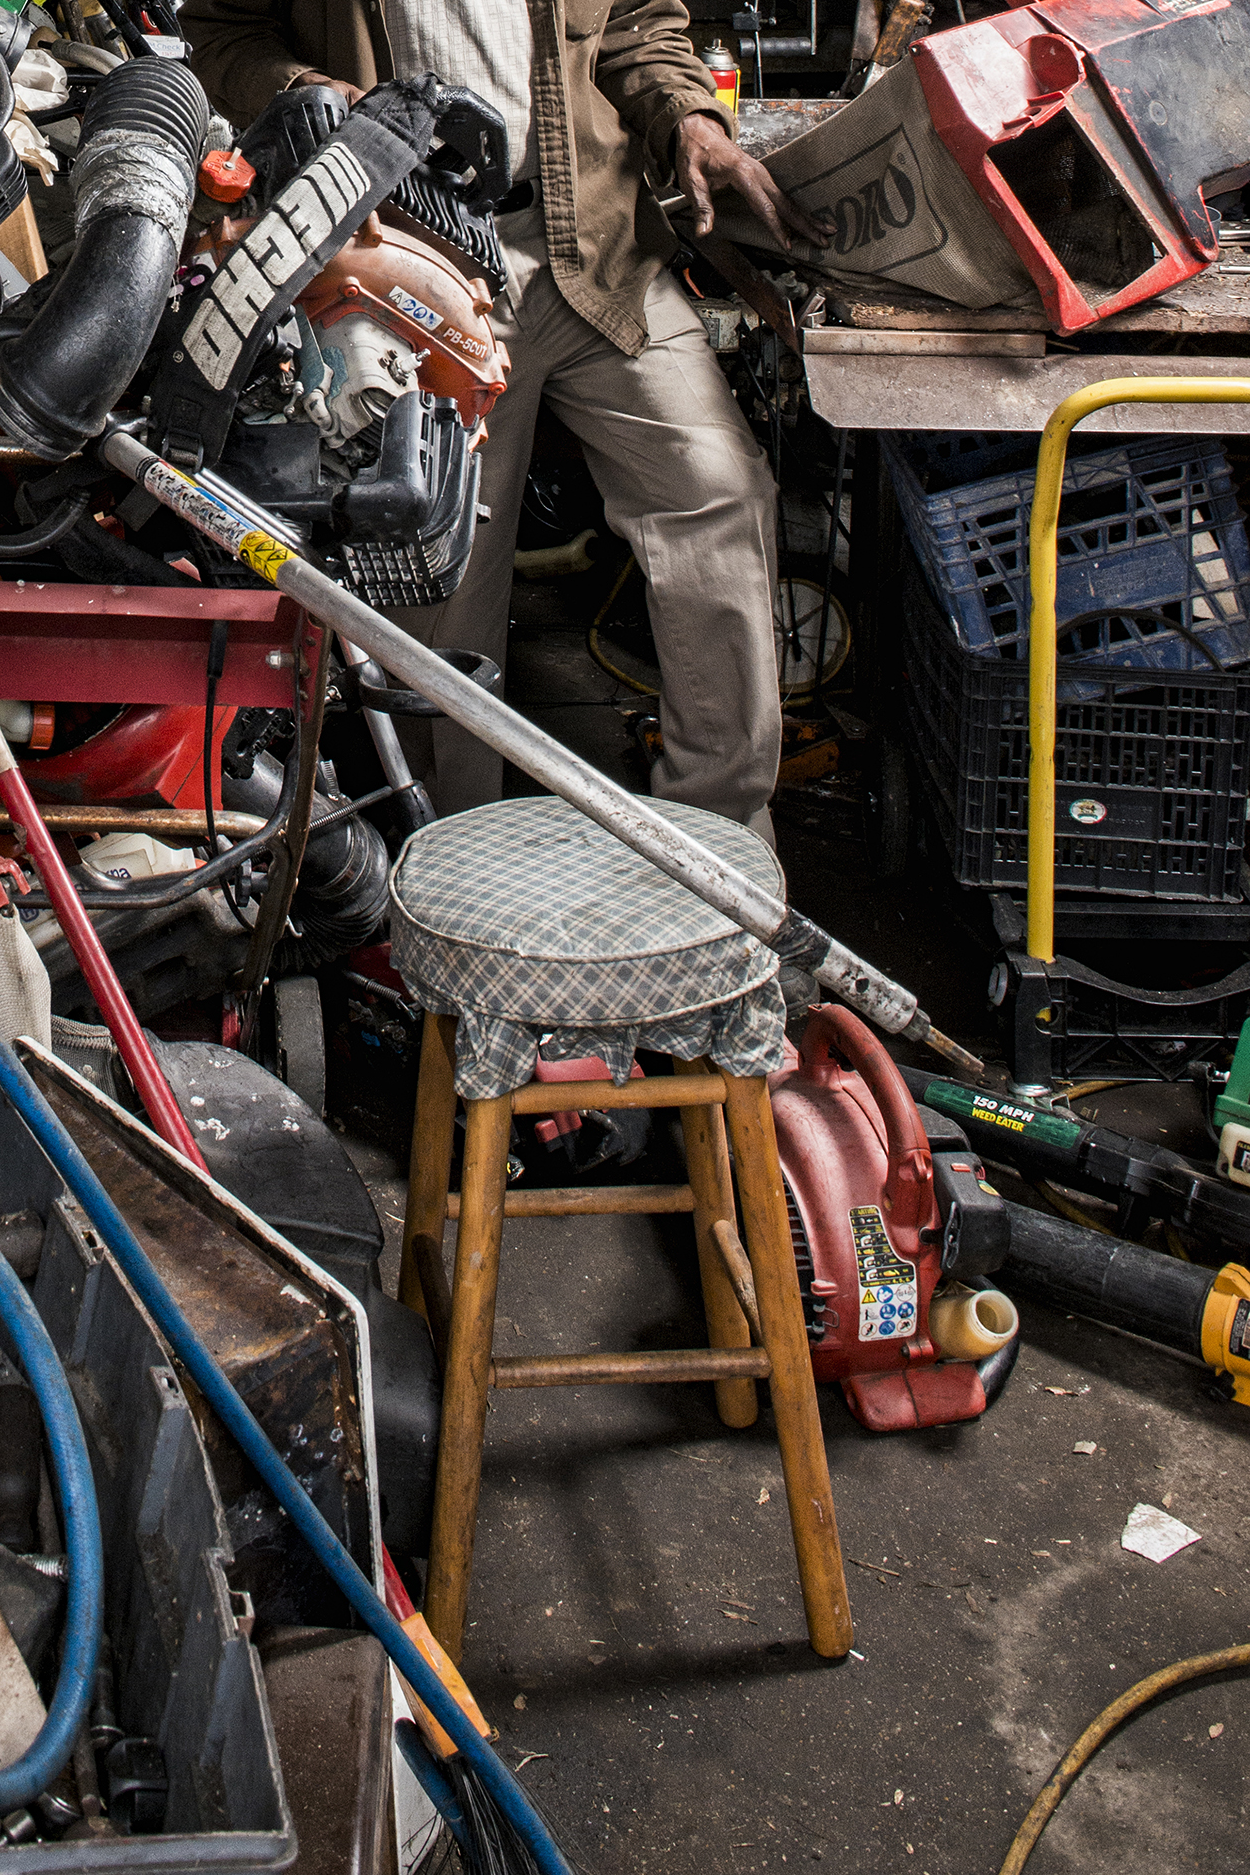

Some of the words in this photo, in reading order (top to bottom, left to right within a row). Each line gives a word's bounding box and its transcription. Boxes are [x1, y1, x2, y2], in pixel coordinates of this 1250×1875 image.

[181, 178, 336, 391] ECHO
[971, 1107, 997, 1123] WEED
[995, 1115, 1026, 1133] EATER
[972, 1095, 999, 1111] 150
[998, 1104, 1035, 1123] MPH
